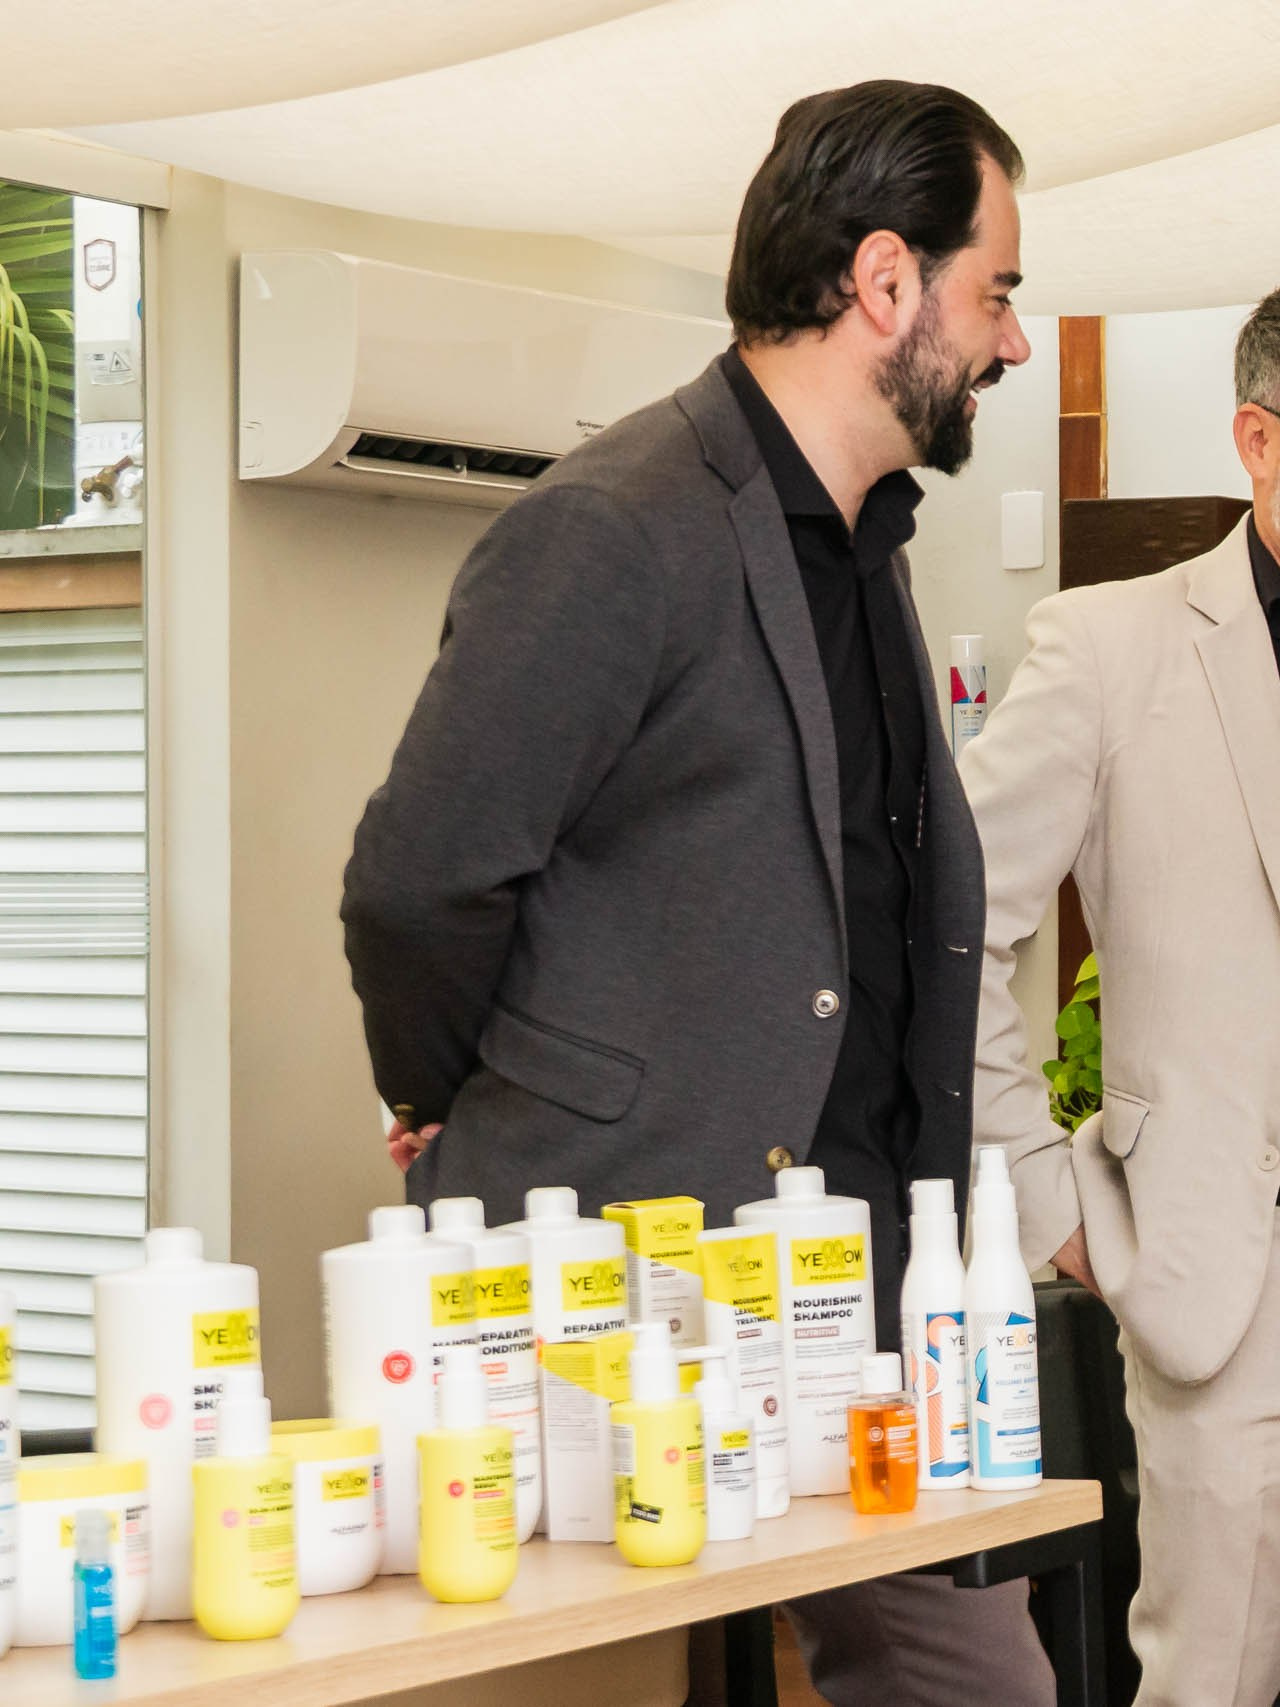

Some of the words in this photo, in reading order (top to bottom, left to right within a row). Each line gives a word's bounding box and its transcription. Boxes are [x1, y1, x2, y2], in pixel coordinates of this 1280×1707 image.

[797, 1240, 863, 1270] YELLOW
[478, 1269, 531, 1301] YELLO
[793, 1294, 862, 1308] NOURISHING
[793, 1309, 853, 1322] SHAMPOO
